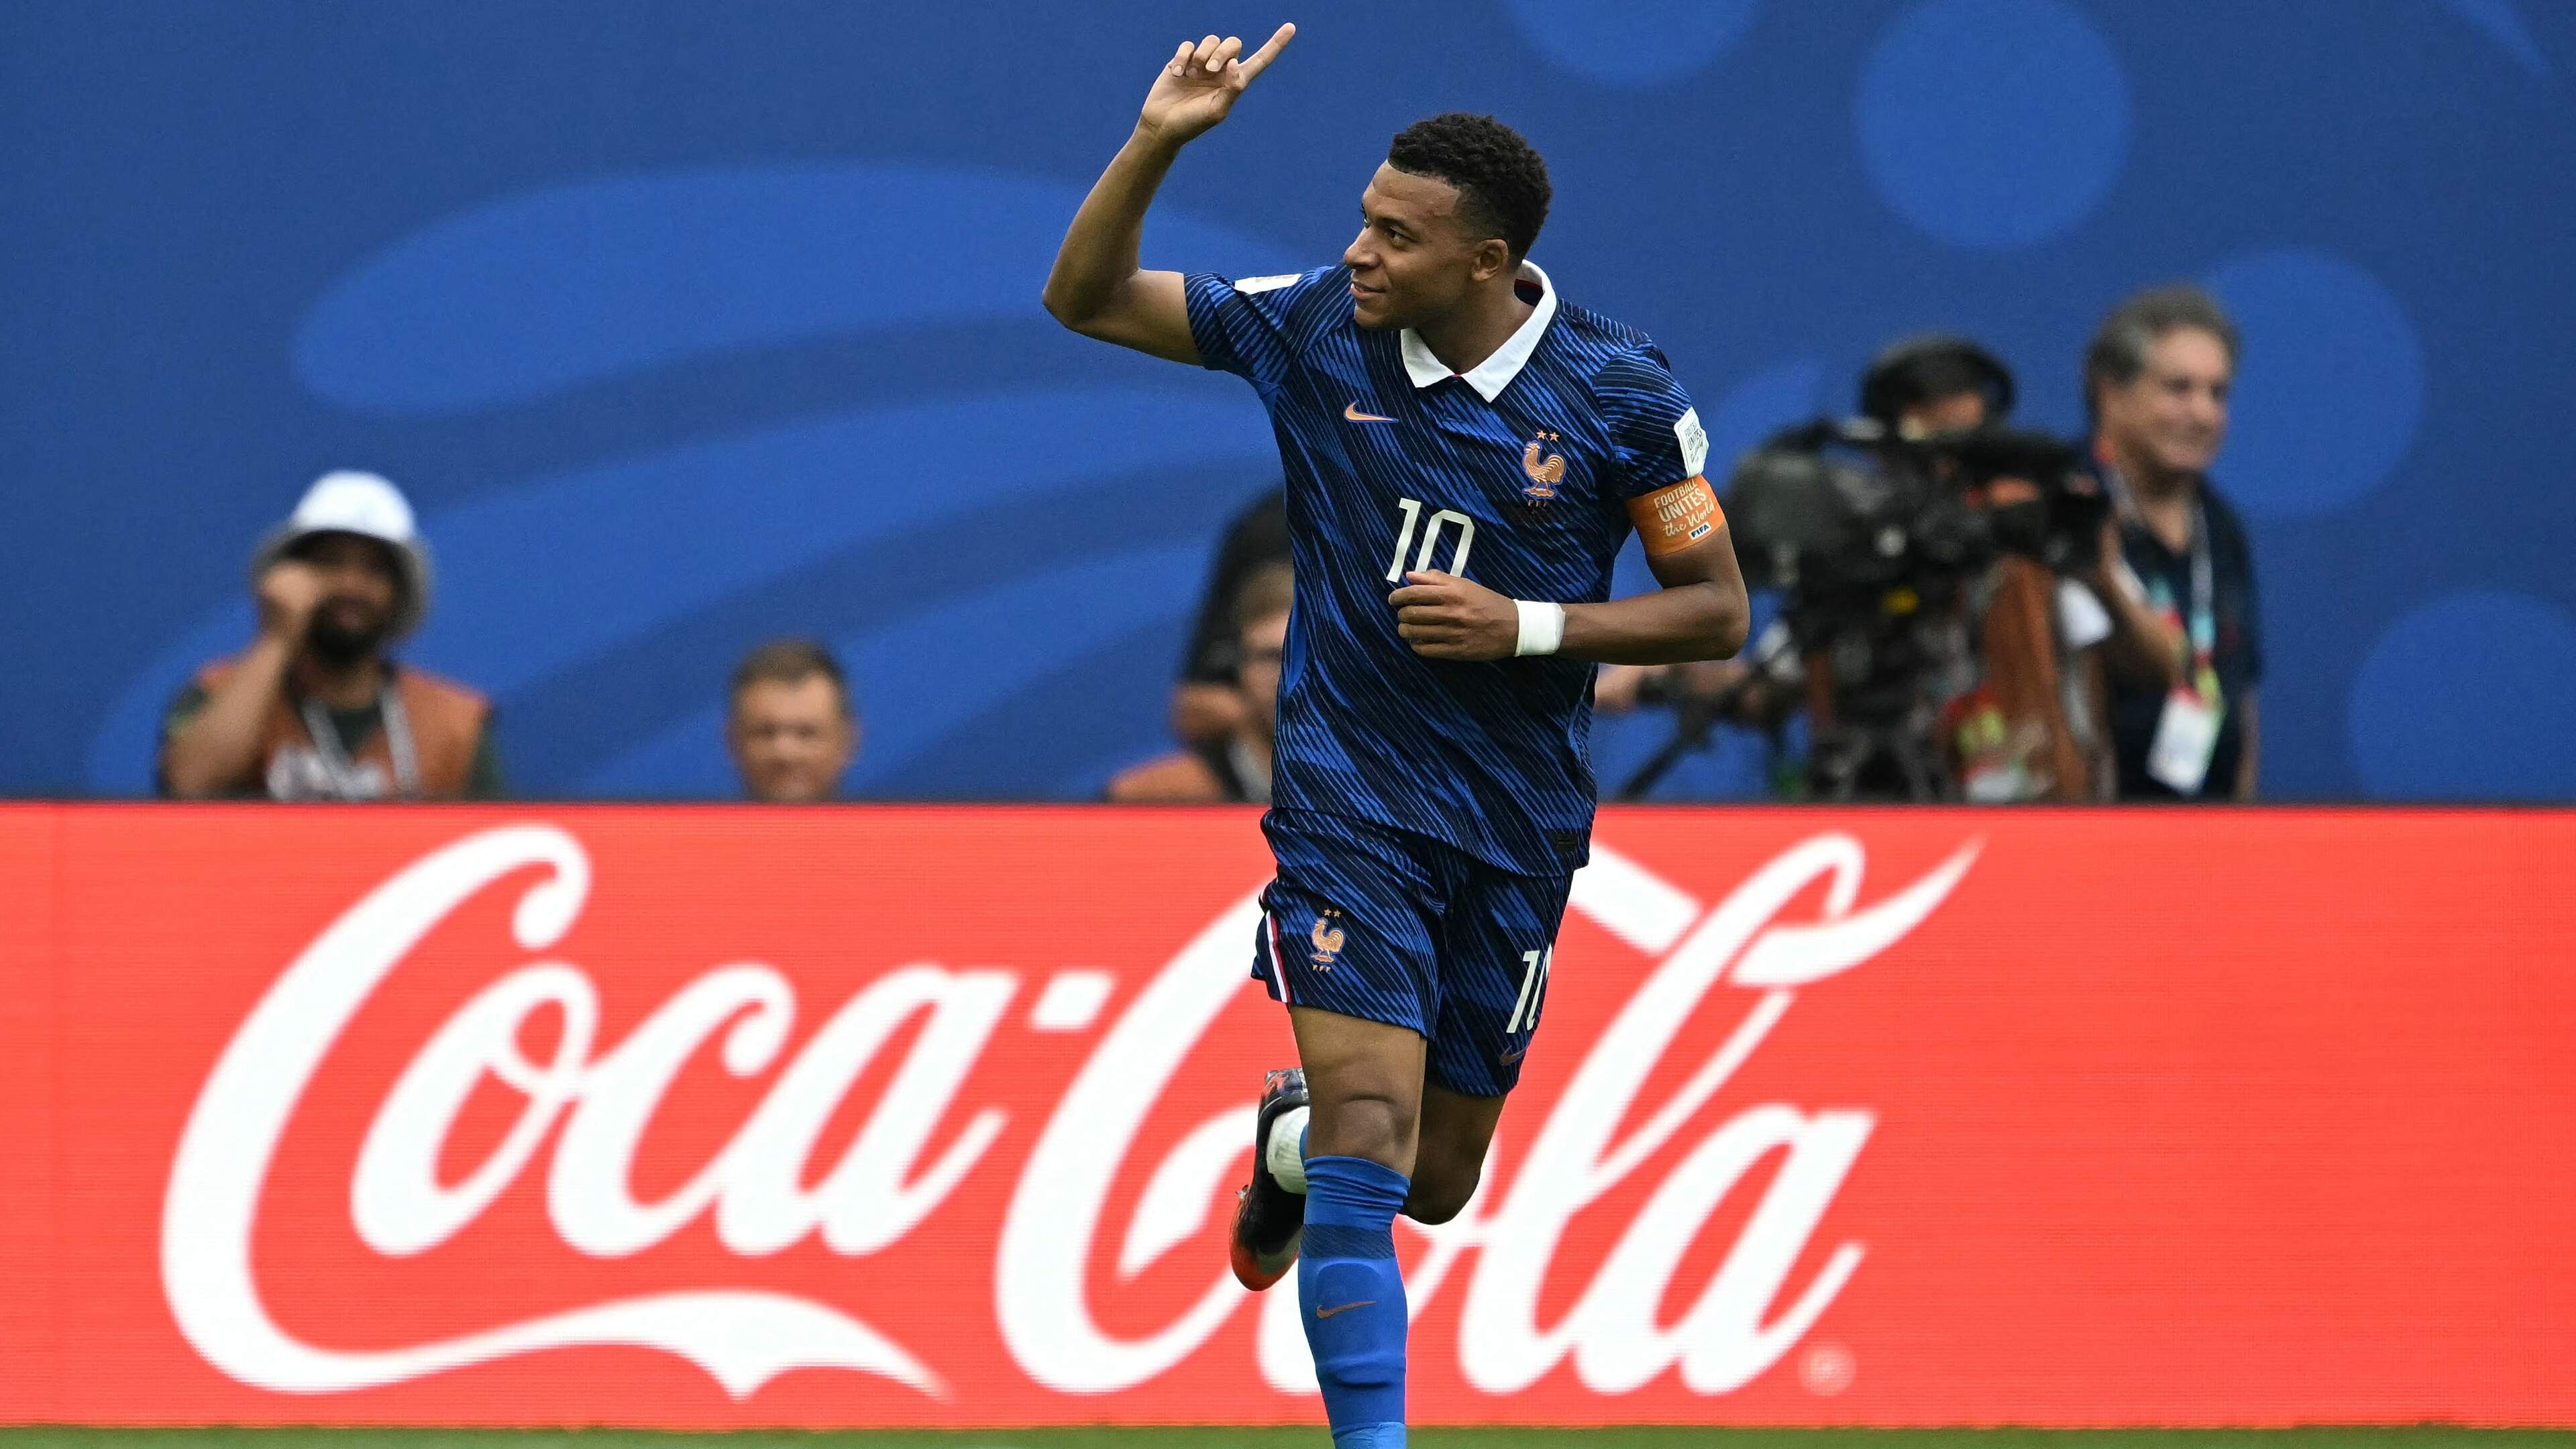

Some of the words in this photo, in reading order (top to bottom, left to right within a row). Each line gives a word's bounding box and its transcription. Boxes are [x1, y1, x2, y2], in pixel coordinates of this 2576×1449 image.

[1654, 478, 1698, 508] FOOTBALL
[1658, 488, 1707, 523] UNITES
[1662, 522, 1686, 537] the
[1686, 498, 1715, 527] World
[1690, 524, 1709, 538] FIFA
[1386, 497, 1474, 583] 10
